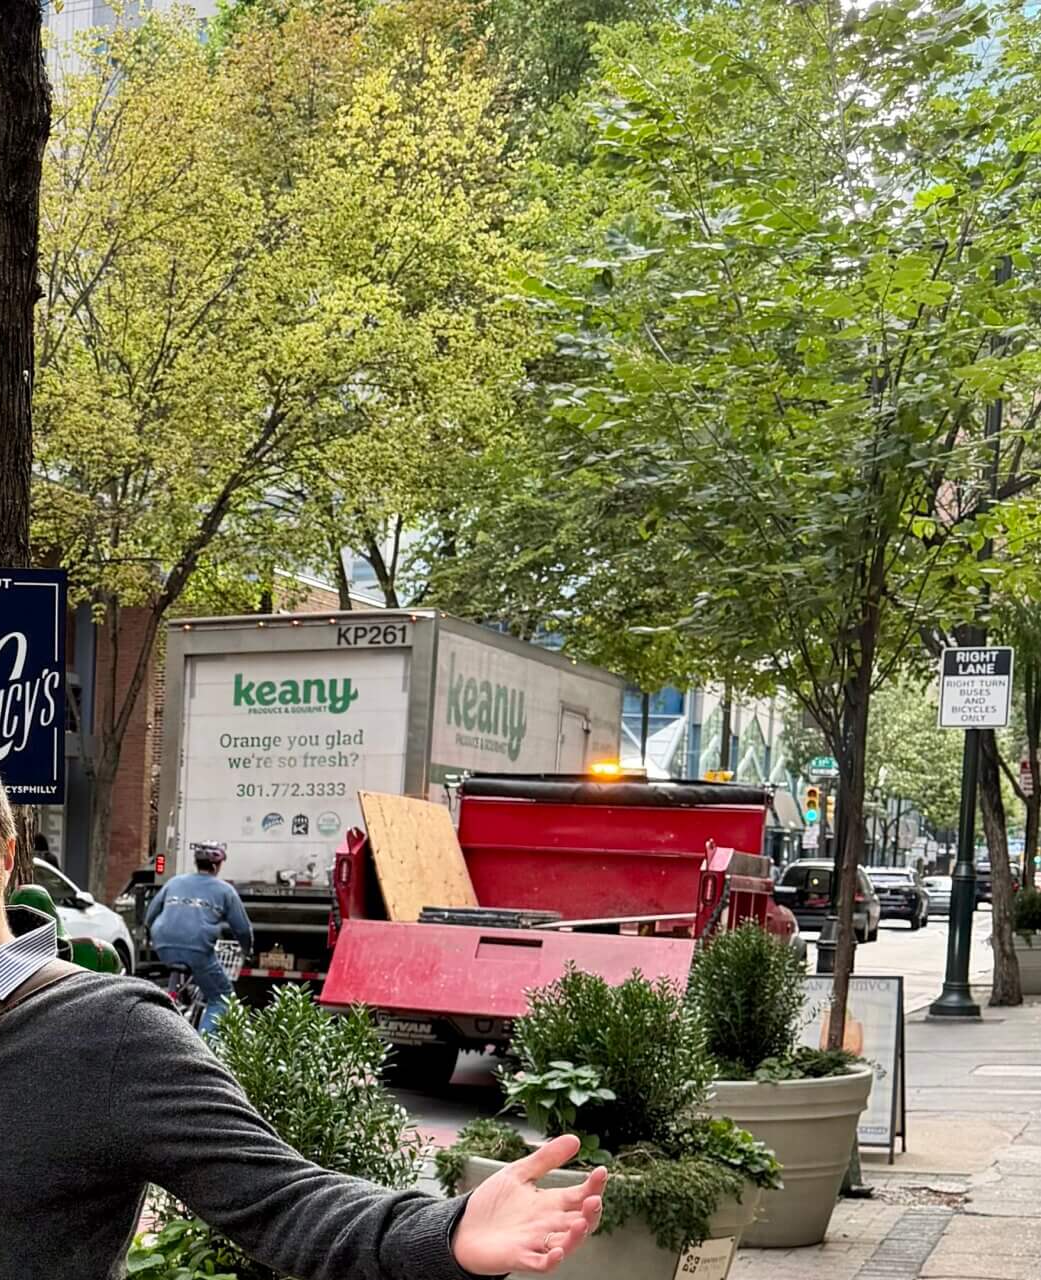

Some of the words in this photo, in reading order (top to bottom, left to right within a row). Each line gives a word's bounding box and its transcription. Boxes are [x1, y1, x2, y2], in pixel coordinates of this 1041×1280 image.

[337, 624, 407, 646] KP261
[956, 651, 999, 662] RIGHT
[958, 663, 996, 675] LANE
[233, 672, 359, 714] keany
[960, 688, 991, 697] BUSES
[447, 652, 527, 762] keany
[964, 697, 986, 705] AND
[951, 705, 997, 714] BICYCLES
[961, 714, 986, 722] ONLY
[220, 733, 282, 751] Orange
[287, 735, 319, 751] you
[325, 729, 363, 750] glad
[228, 752, 272, 768] we're
[278, 756, 297, 768] so
[302, 751, 359, 768] fresh?
[236, 782, 346, 798] 301.772.3333
